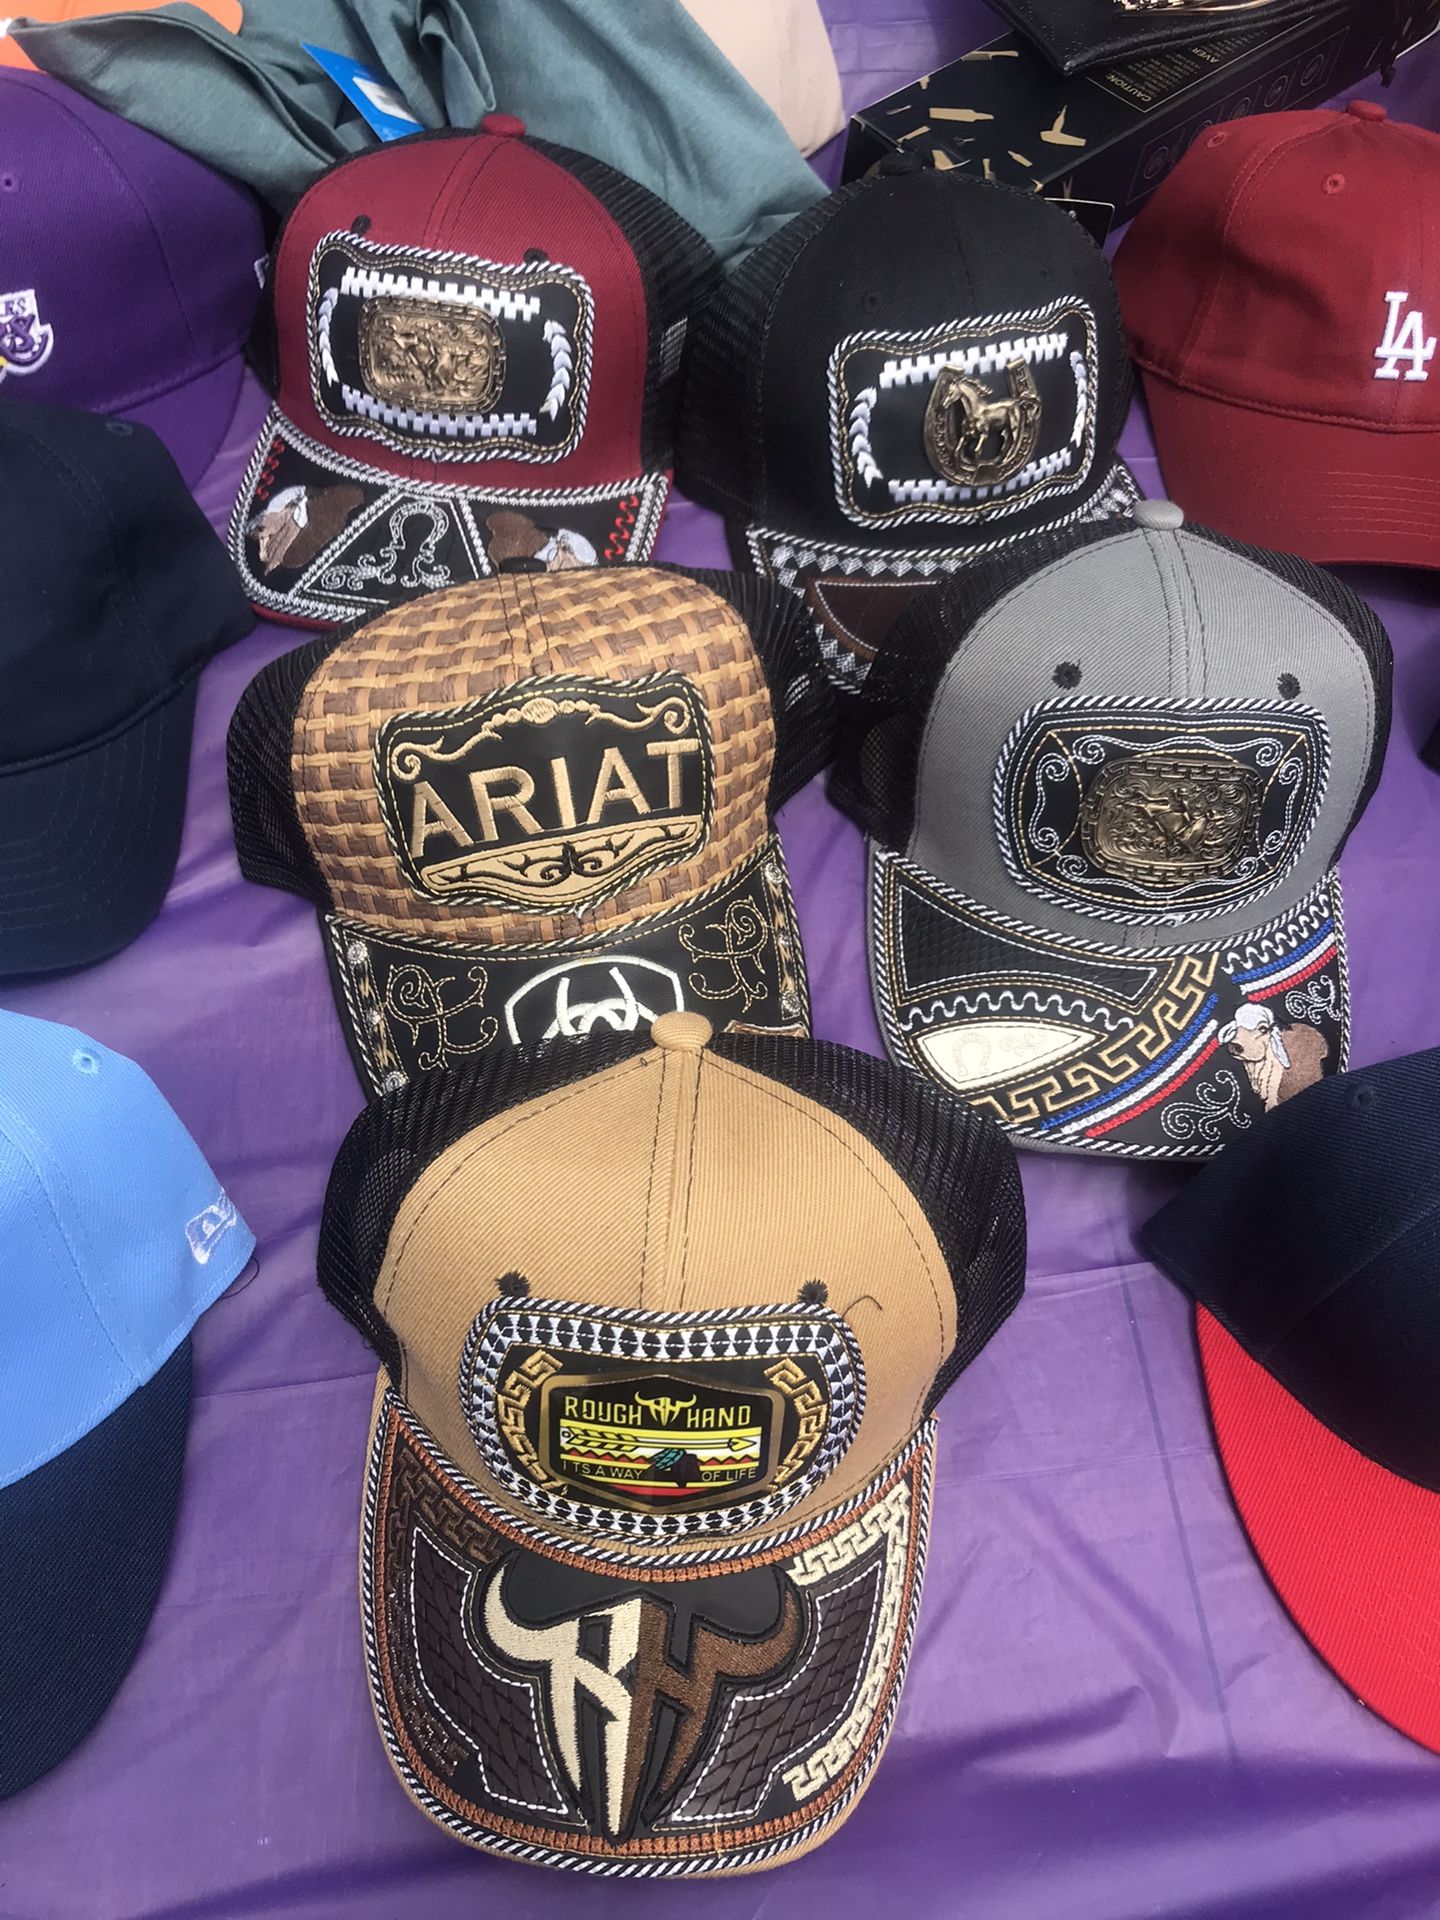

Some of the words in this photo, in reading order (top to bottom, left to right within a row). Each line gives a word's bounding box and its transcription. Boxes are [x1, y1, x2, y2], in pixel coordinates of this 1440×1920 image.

[1374, 291, 1437, 381] LA
[411, 738, 700, 857] ARIAT
[564, 1395, 642, 1426] ROUGH
[686, 1405, 751, 1429] HAND
[595, 1465, 606, 1476] A
[609, 1466, 643, 1480] WAY
[701, 1470, 721, 1482] OF
[725, 1467, 757, 1481] LIFE
